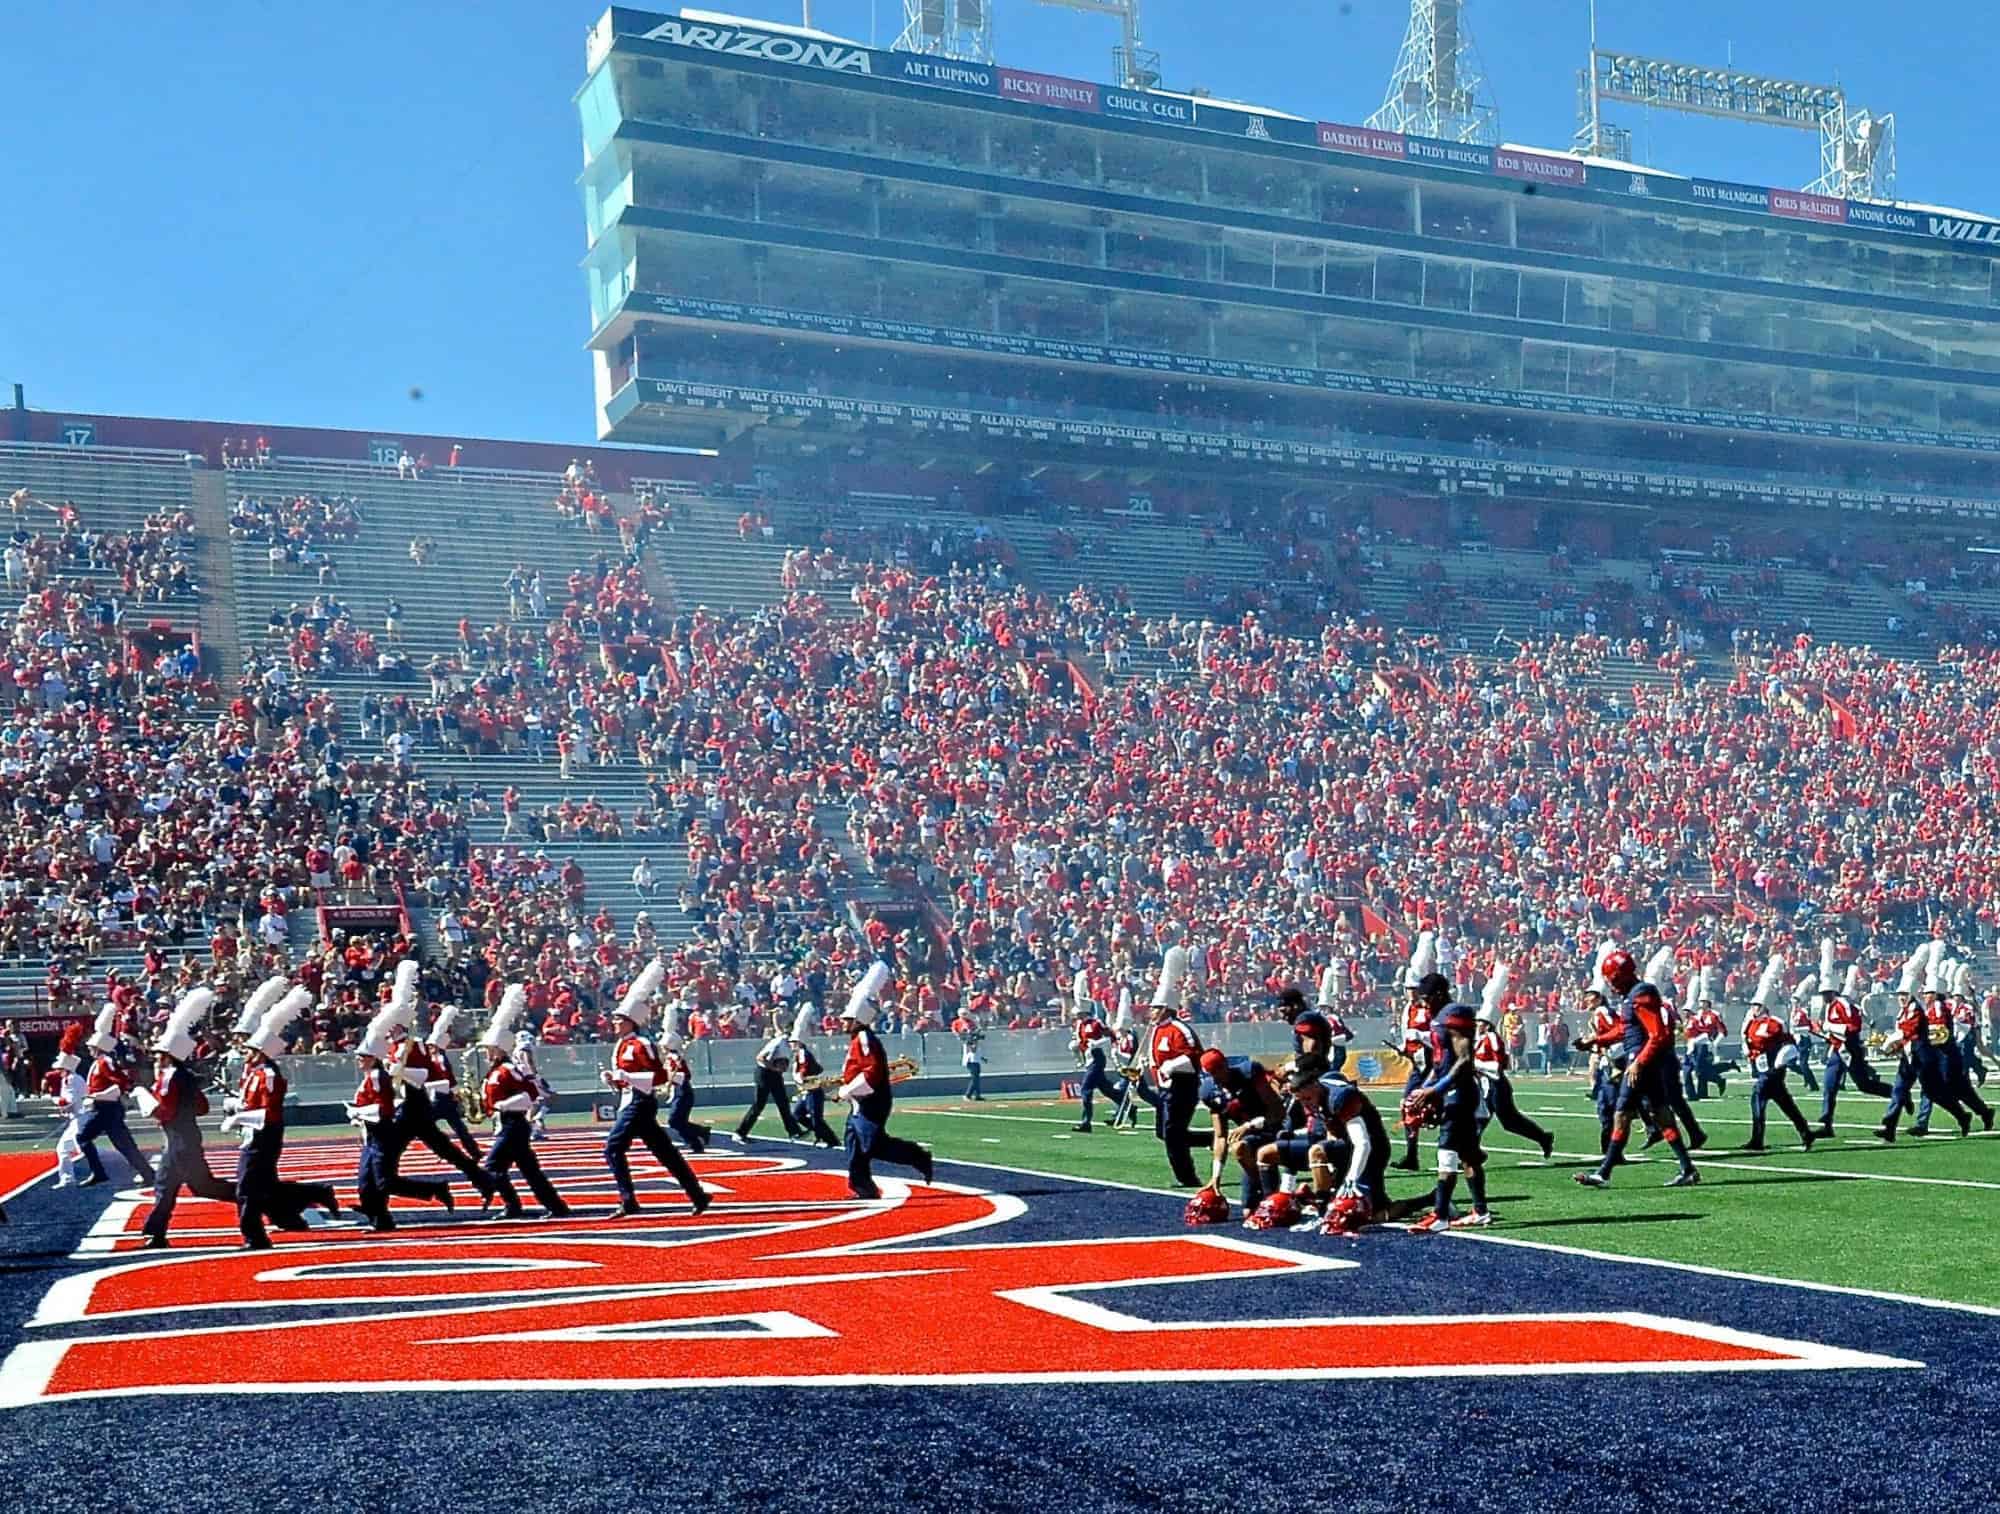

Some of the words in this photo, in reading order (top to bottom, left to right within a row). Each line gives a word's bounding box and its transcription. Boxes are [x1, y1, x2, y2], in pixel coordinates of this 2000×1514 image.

[641, 21, 871, 74] ARIZONA
[904, 61, 929, 76] ART
[934, 65, 989, 86] LUPPINO
[1003, 77, 1041, 95] RICKY
[1045, 84, 1092, 104] HUNLEY
[1107, 95, 1148, 113] CHUCK
[1153, 103, 1187, 119] CECIL
[1372, 139, 1403, 153] LEWIS
[1497, 156, 1520, 170] ROB
[1523, 160, 1575, 178] WALDROP
[1692, 184, 1716, 199] STEVE
[1773, 197, 1797, 210] CHRIS
[1887, 214, 1916, 228] CASON
[657, 383, 685, 394] DAVE
[688, 386, 733, 399] HIBBERT
[739, 390, 768, 402] WALT
[771, 392, 821, 408] STANTON
[827, 400, 854, 410] WALT
[910, 407, 938, 419] TONY
[980, 415, 1013, 427] ALLAN
[1062, 423, 1100, 435] HAROLD
[65, 430, 90, 446] 17
[373, 447, 398, 464] 18
[1128, 498, 1152, 514] 20
[19, 1019, 58, 1032] SECTION
